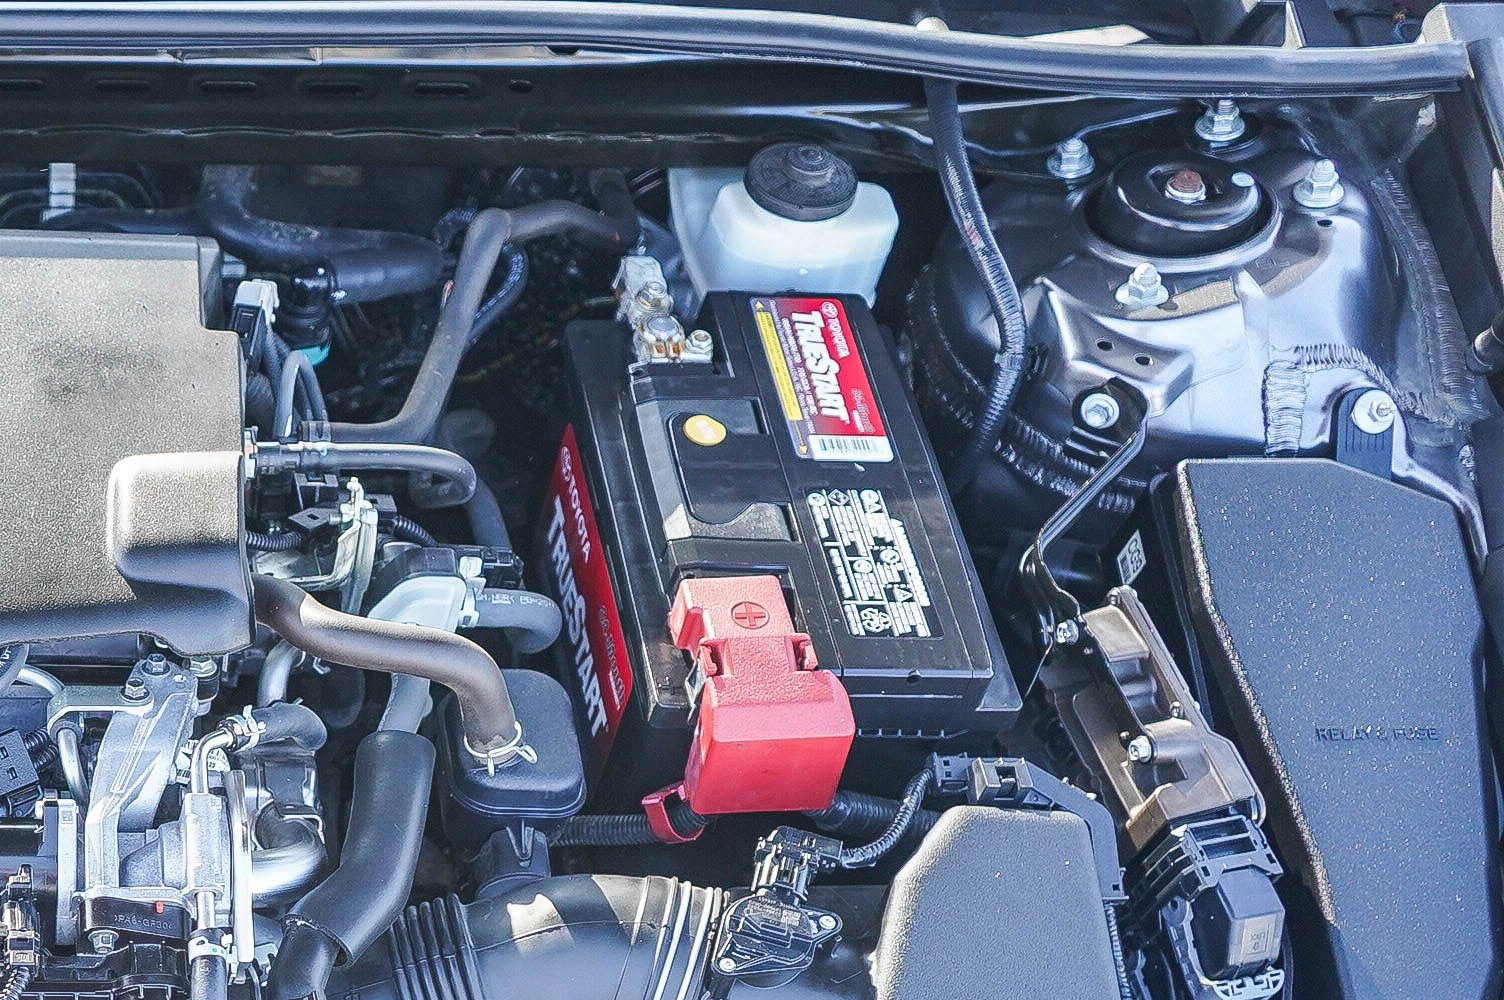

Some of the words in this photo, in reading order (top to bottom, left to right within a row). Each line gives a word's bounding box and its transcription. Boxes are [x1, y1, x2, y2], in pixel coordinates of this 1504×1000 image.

[827, 317, 851, 359] TOYOTA
[568, 475, 591, 564] TOYOTA
[1315, 725, 1372, 741] RELAY
[1392, 727, 1439, 741] FUSE
